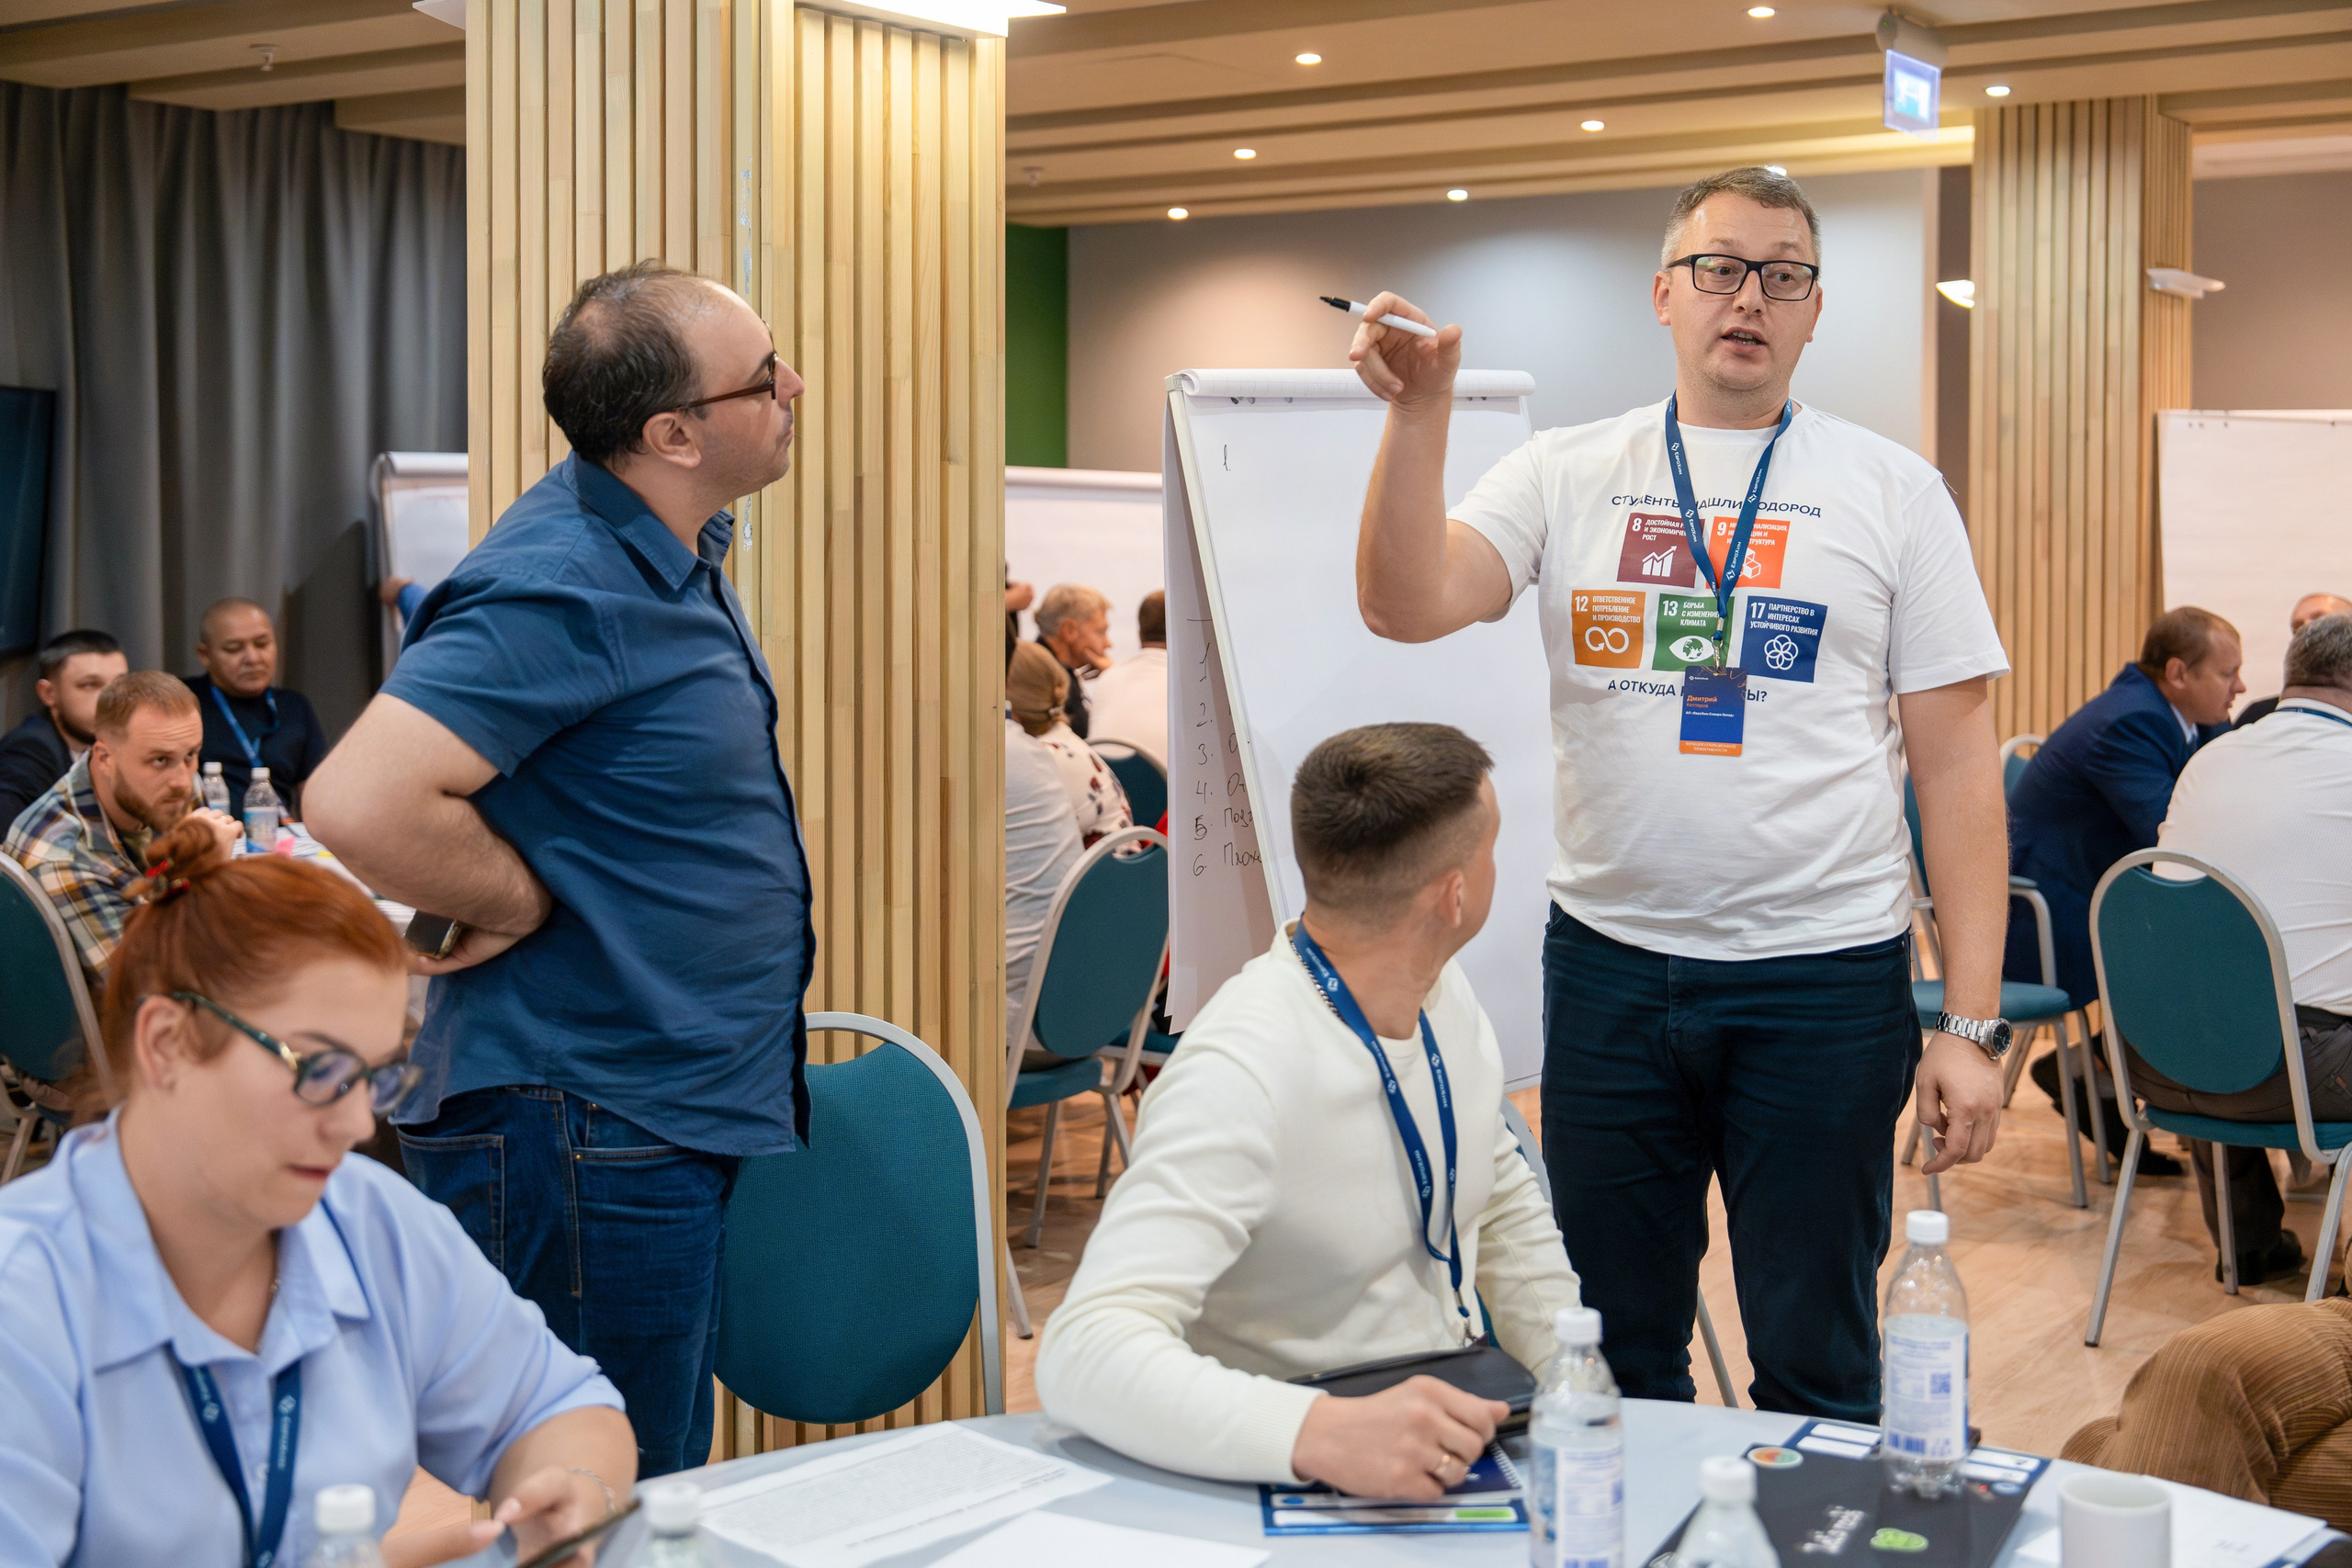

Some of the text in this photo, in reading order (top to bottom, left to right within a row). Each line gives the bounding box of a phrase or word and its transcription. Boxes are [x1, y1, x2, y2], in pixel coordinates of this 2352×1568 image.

[1757, 501, 1822, 518] ОДОРОД
[1632, 517, 1643, 532] 8
[1645, 518, 1679, 528] ДОСТОЙНАЯ
[1716, 521, 1727, 536] 9
[1575, 595, 1589, 612] 12
[1592, 595, 1636, 604] ОТВЕТСТВЕННОЕ
[1592, 604, 1630, 614] ПОТРЕБЛЕНИЕ
[1662, 600, 1679, 616] 13
[1686, 610, 1720, 618] ИЗМЕНЕНИЕ
[1750, 602, 1766, 619] 17
[1768, 603, 1810, 615] ПАРТНЕРСТВО
[1597, 615, 1641, 624] ПРОИЗВОДСТВО
[1679, 618, 1707, 627] КЛИМАТА
[1767, 613, 1801, 624] ИНТЕРЕСАХ
[1749, 620, 1819, 637] УСТОЙЧИВОГО РАЗВИТИЯ
[1608, 679, 1617, 691] А
[1619, 679, 1676, 697] ОТКУДА
[1745, 688, 1768, 703] Ы?
[1686, 694, 1718, 704] Дмитрий
[1197, 743, 1214, 765] 3.
[1195, 780, 1213, 804] 4.
[1193, 853, 1207, 877] 6.
